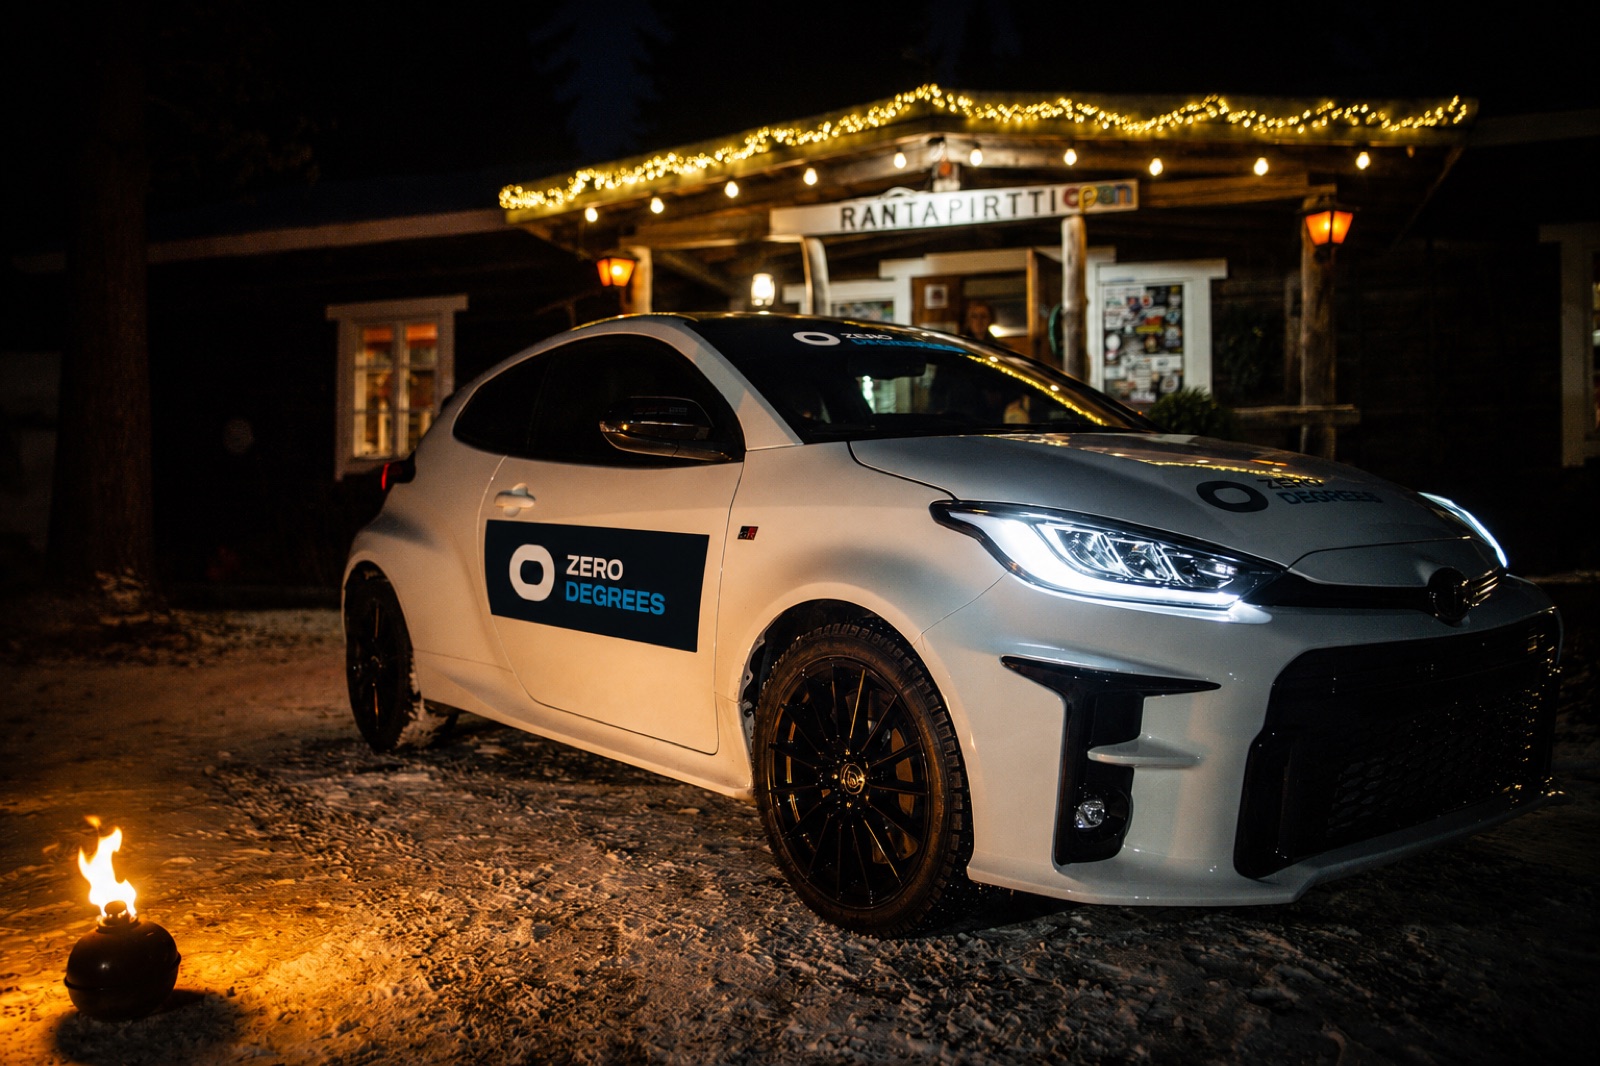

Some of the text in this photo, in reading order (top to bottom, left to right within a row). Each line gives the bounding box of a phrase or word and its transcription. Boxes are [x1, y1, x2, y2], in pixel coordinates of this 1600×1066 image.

[840, 189, 1056, 232] RANTAPIRTTI
[840, 332, 894, 340] ZERO
[1257, 477, 1325, 490] ZERO
[1276, 490, 1384, 505] DEGREES
[566, 554, 624, 581] ZERO
[565, 581, 666, 615] DEGREES
